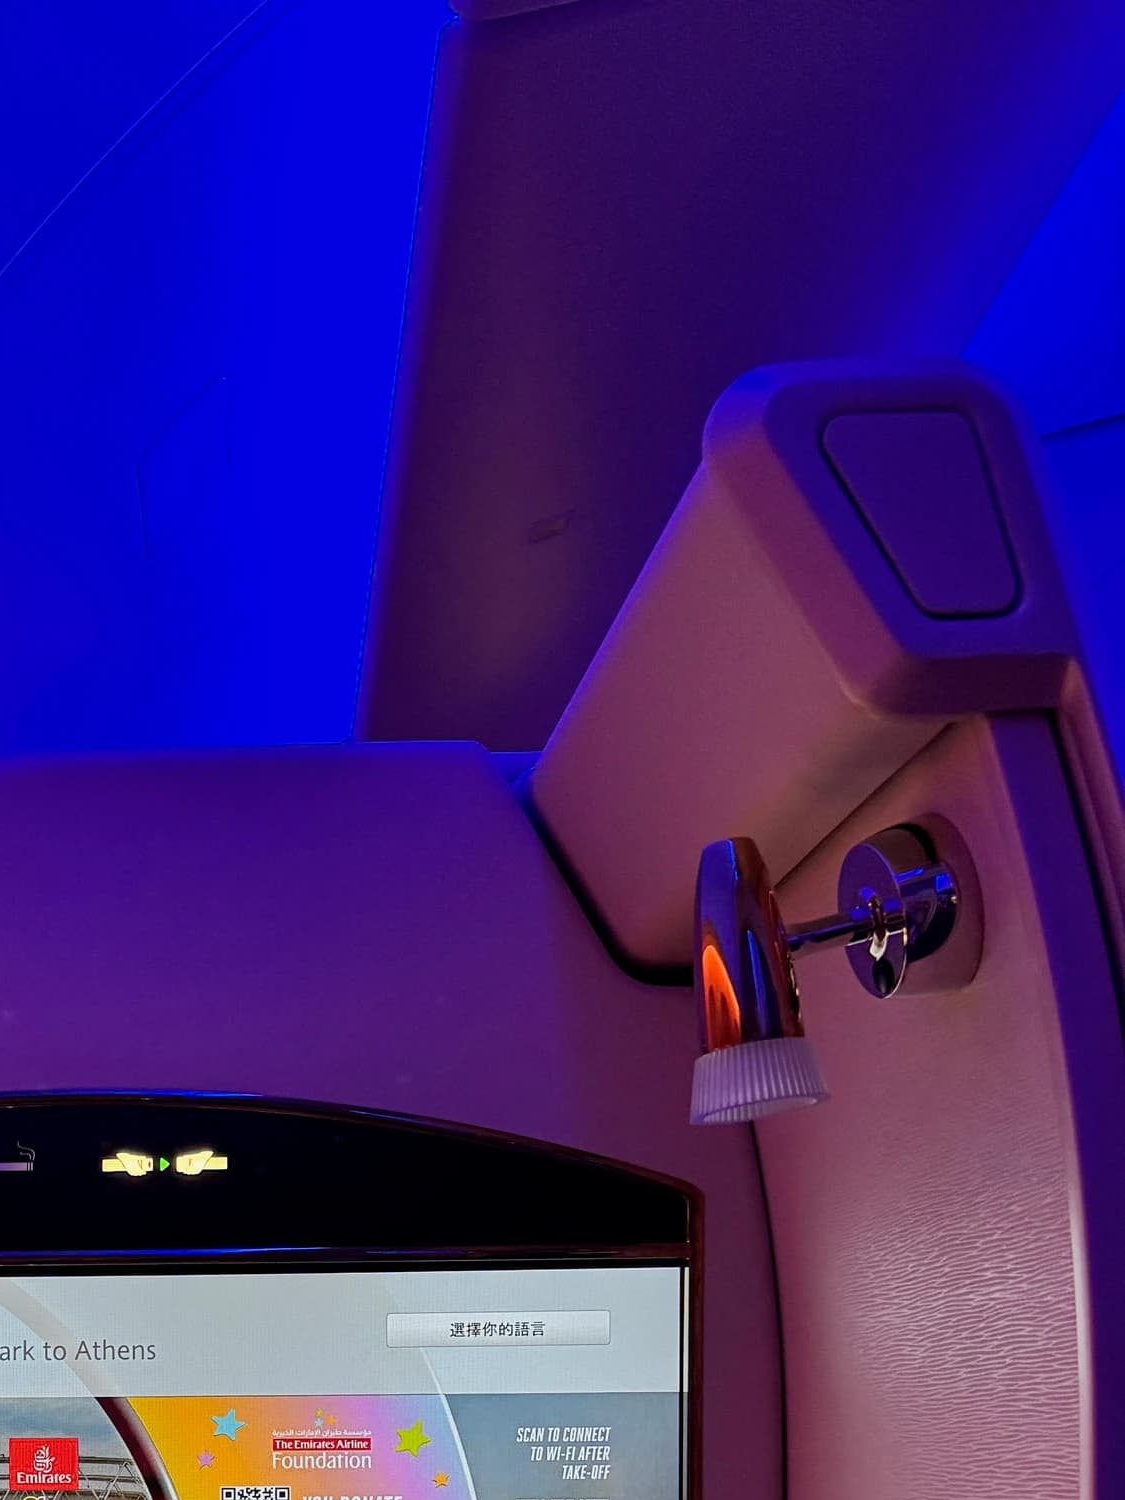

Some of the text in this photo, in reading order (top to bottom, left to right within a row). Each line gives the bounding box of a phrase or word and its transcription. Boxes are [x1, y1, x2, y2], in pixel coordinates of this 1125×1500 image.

[450, 1321, 546, 1338] 選擇你的語言
[42, 1341, 67, 1362] to
[74, 1338, 157, 1361] Athens
[516, 1426, 611, 1442] SCAN TO CONNECT
[275, 1439, 369, 1449] The Emirates Airline
[272, 1451, 372, 1469] Foundation
[530, 1446, 610, 1461] TO WI-FI AFTER
[16, 1471, 72, 1485] Emirates
[562, 1465, 611, 1480] TAKE-OFF
